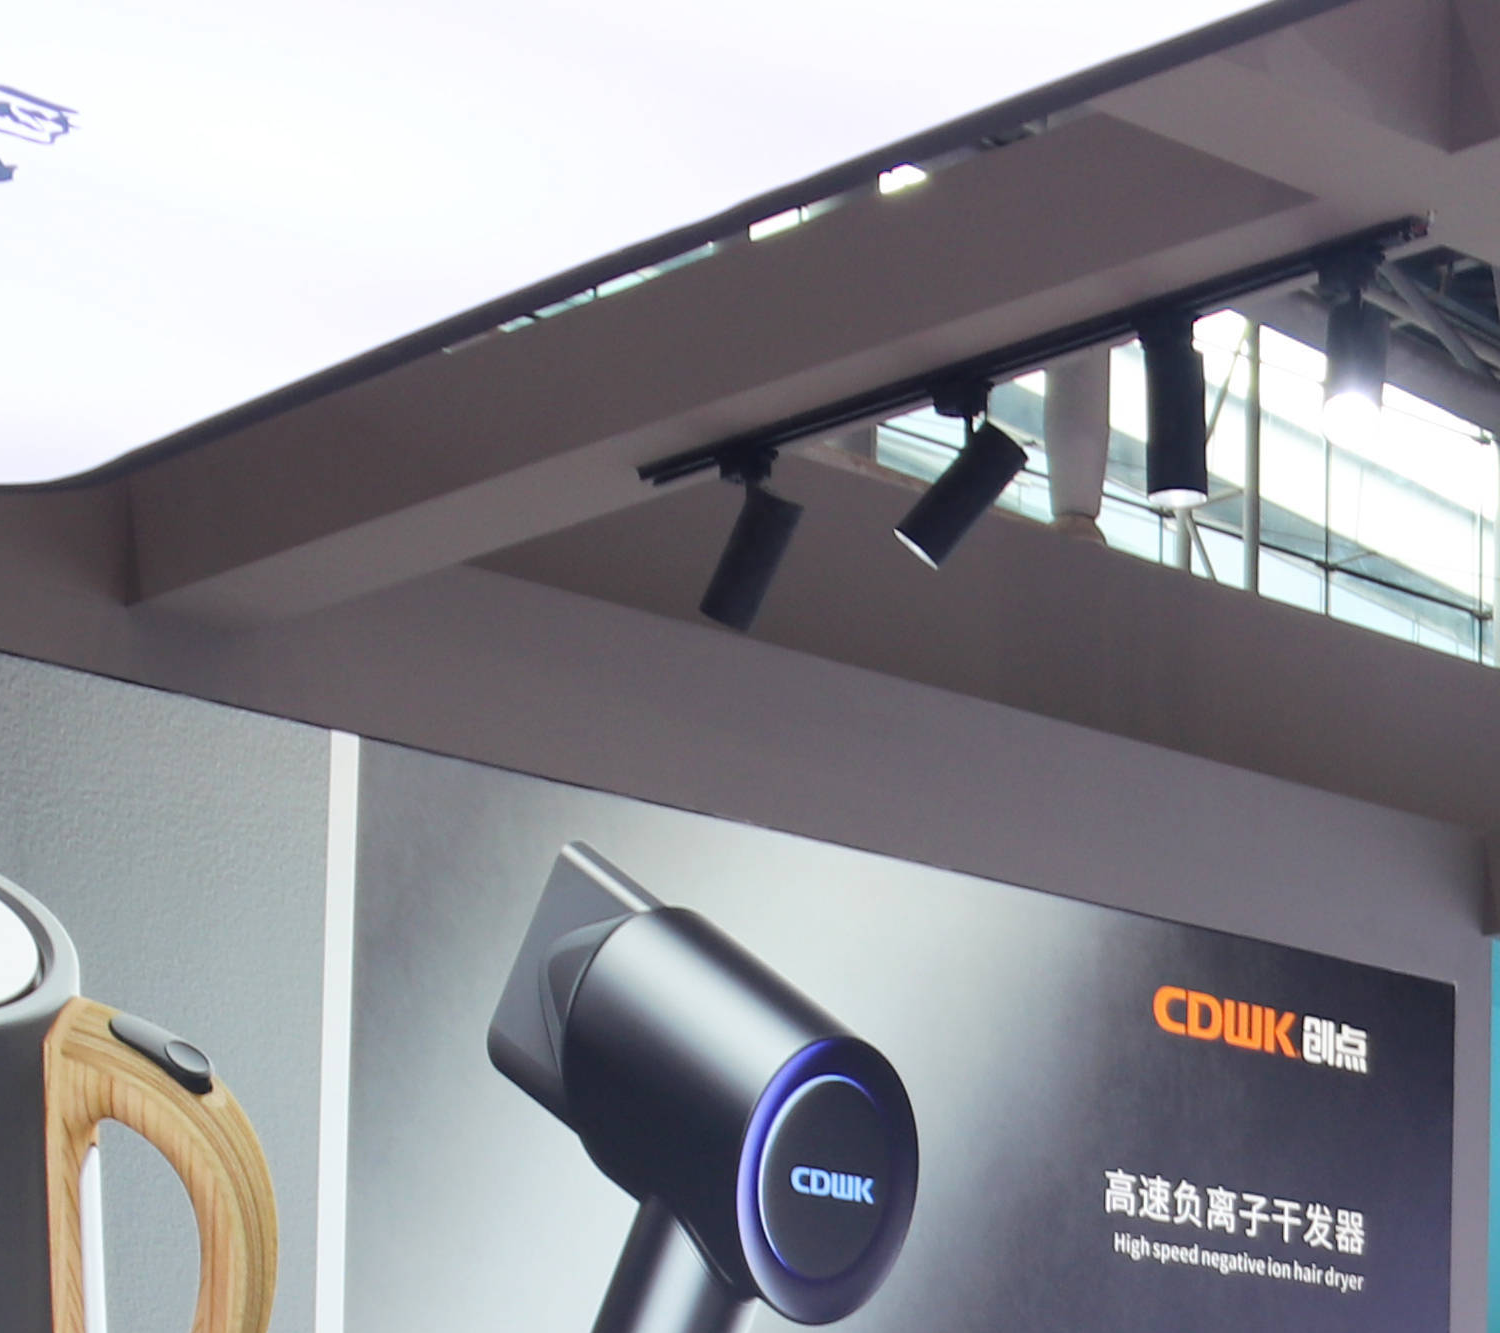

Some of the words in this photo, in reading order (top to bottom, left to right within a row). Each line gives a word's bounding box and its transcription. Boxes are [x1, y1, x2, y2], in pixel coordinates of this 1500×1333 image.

[1153, 984, 1298, 1059] CDWK
[1302, 1014, 1369, 1074] 创点
[790, 1166, 875, 1205] CDWK
[1103, 1168, 1366, 1256] 高速负离子干发器
[1114, 1232, 1151, 1261] High
[1152, 1242, 1200, 1269] speed
[1201, 1248, 1265, 1277] negative
[1267, 1257, 1292, 1281] ion
[1293, 1261, 1323, 1285] hair
[1324, 1266, 1365, 1293] dryer
